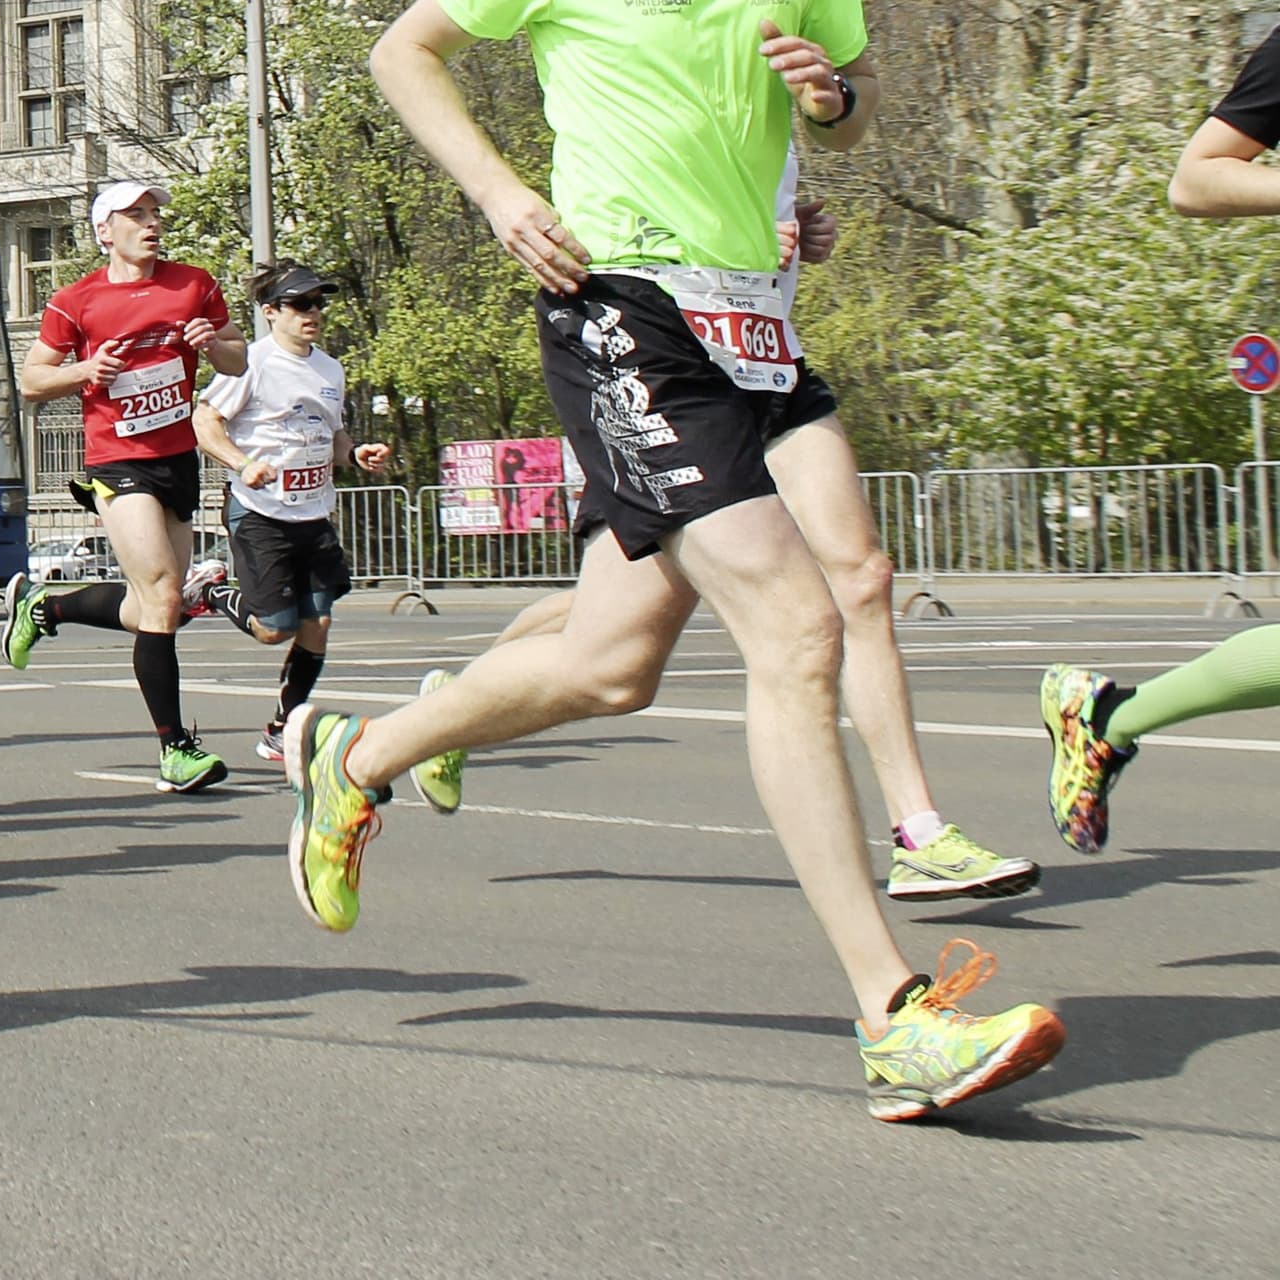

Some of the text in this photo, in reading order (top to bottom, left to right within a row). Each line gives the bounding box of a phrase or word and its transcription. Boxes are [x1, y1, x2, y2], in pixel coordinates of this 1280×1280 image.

[693, 315, 779, 359] 21669
[120, 386, 185, 419] 22081
[139, 380, 164, 392] Patrick
